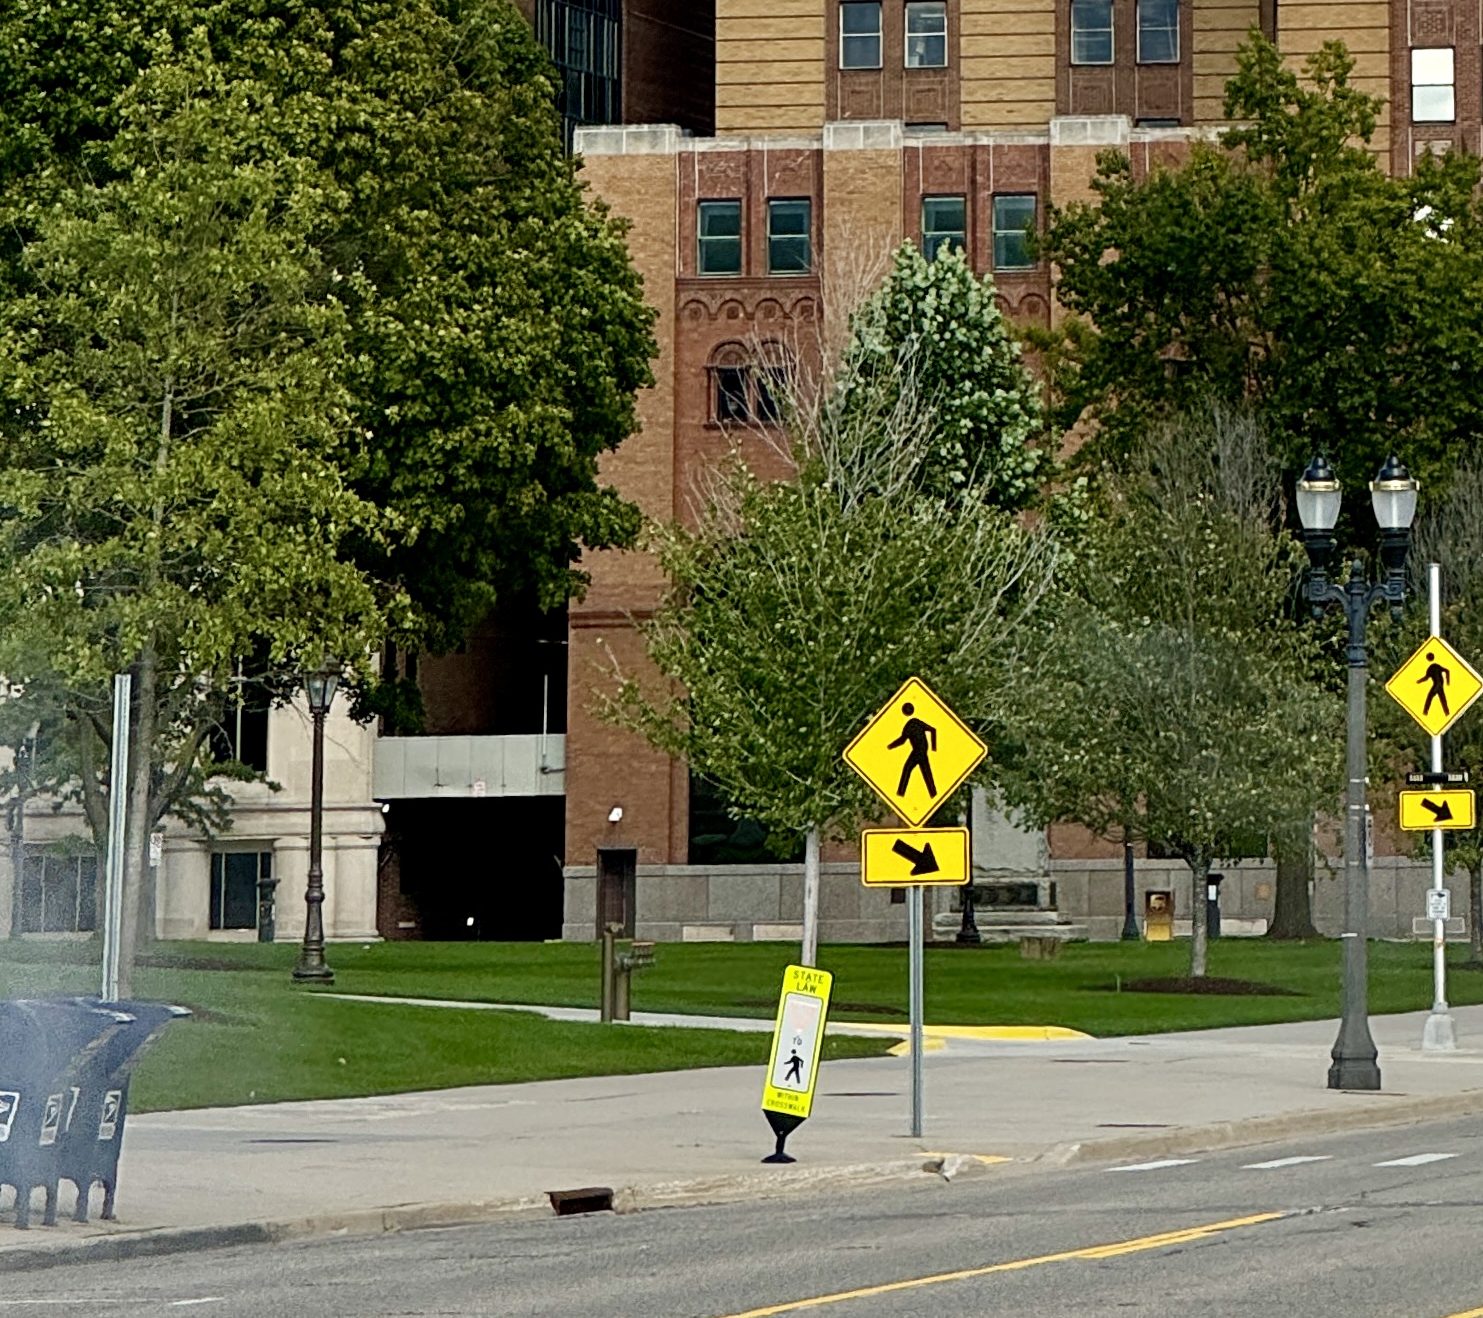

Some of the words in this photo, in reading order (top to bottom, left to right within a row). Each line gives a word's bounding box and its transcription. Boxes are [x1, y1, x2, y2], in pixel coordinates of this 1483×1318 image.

[793, 970, 824, 984] STATE
[796, 981, 817, 994] LAW
[792, 1035, 803, 1046] TO
[776, 1091, 800, 1102] WITHIN
[766, 1098, 806, 1113] CROSSWALK
